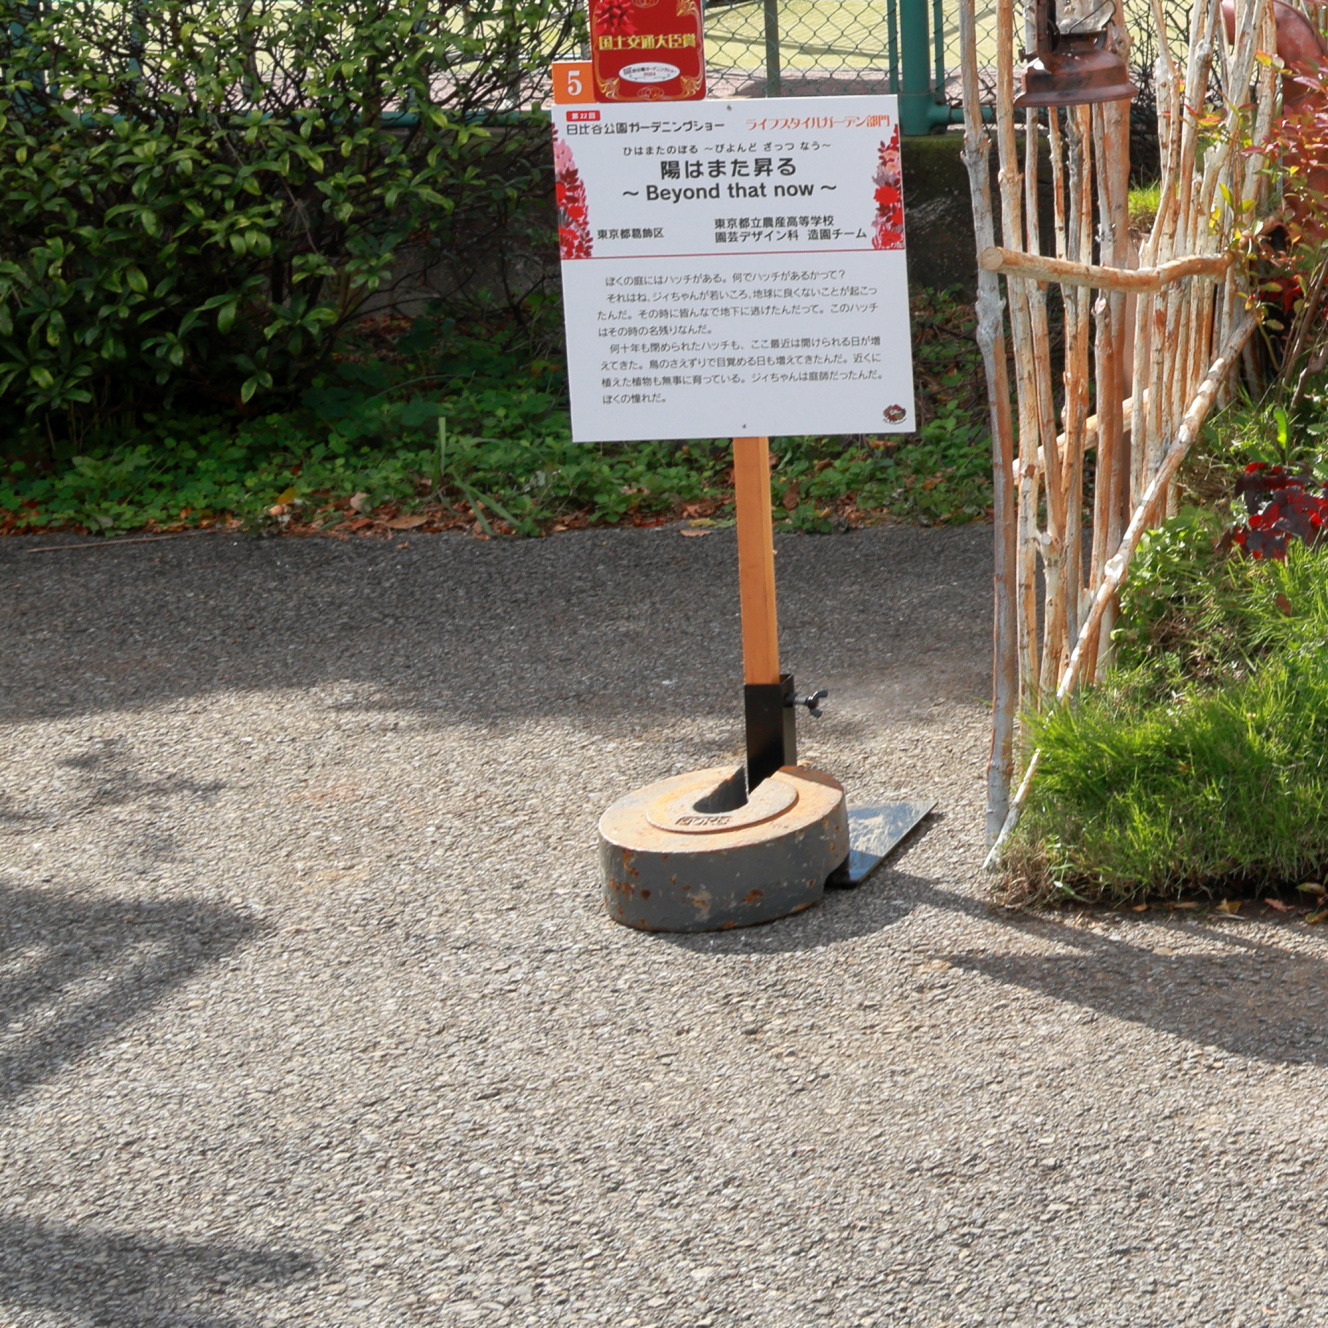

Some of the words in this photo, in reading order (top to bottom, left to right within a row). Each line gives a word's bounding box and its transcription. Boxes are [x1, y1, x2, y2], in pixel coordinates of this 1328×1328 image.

[599, 34, 696, 51] 国土交通大臣賞
[567, 70, 583, 96] 5
[566, 122, 725, 136] 日比谷公園ガーデニングショー
[745, 115, 891, 131] ライフスタイルガーデン部門
[623, 145, 698, 156] ひはまたのぼる
[660, 157, 796, 180] 陽はまた昇る
[646, 183, 720, 204] Beyond
[727, 182, 767, 199] that
[774, 184, 814, 197] now
[714, 215, 834, 230] 東京都立農産高等学校
[597, 227, 664, 240] 東京都葛飾区
[715, 229, 799, 243] 園芸デザイン科
[807, 228, 867, 240] 造園チーム
